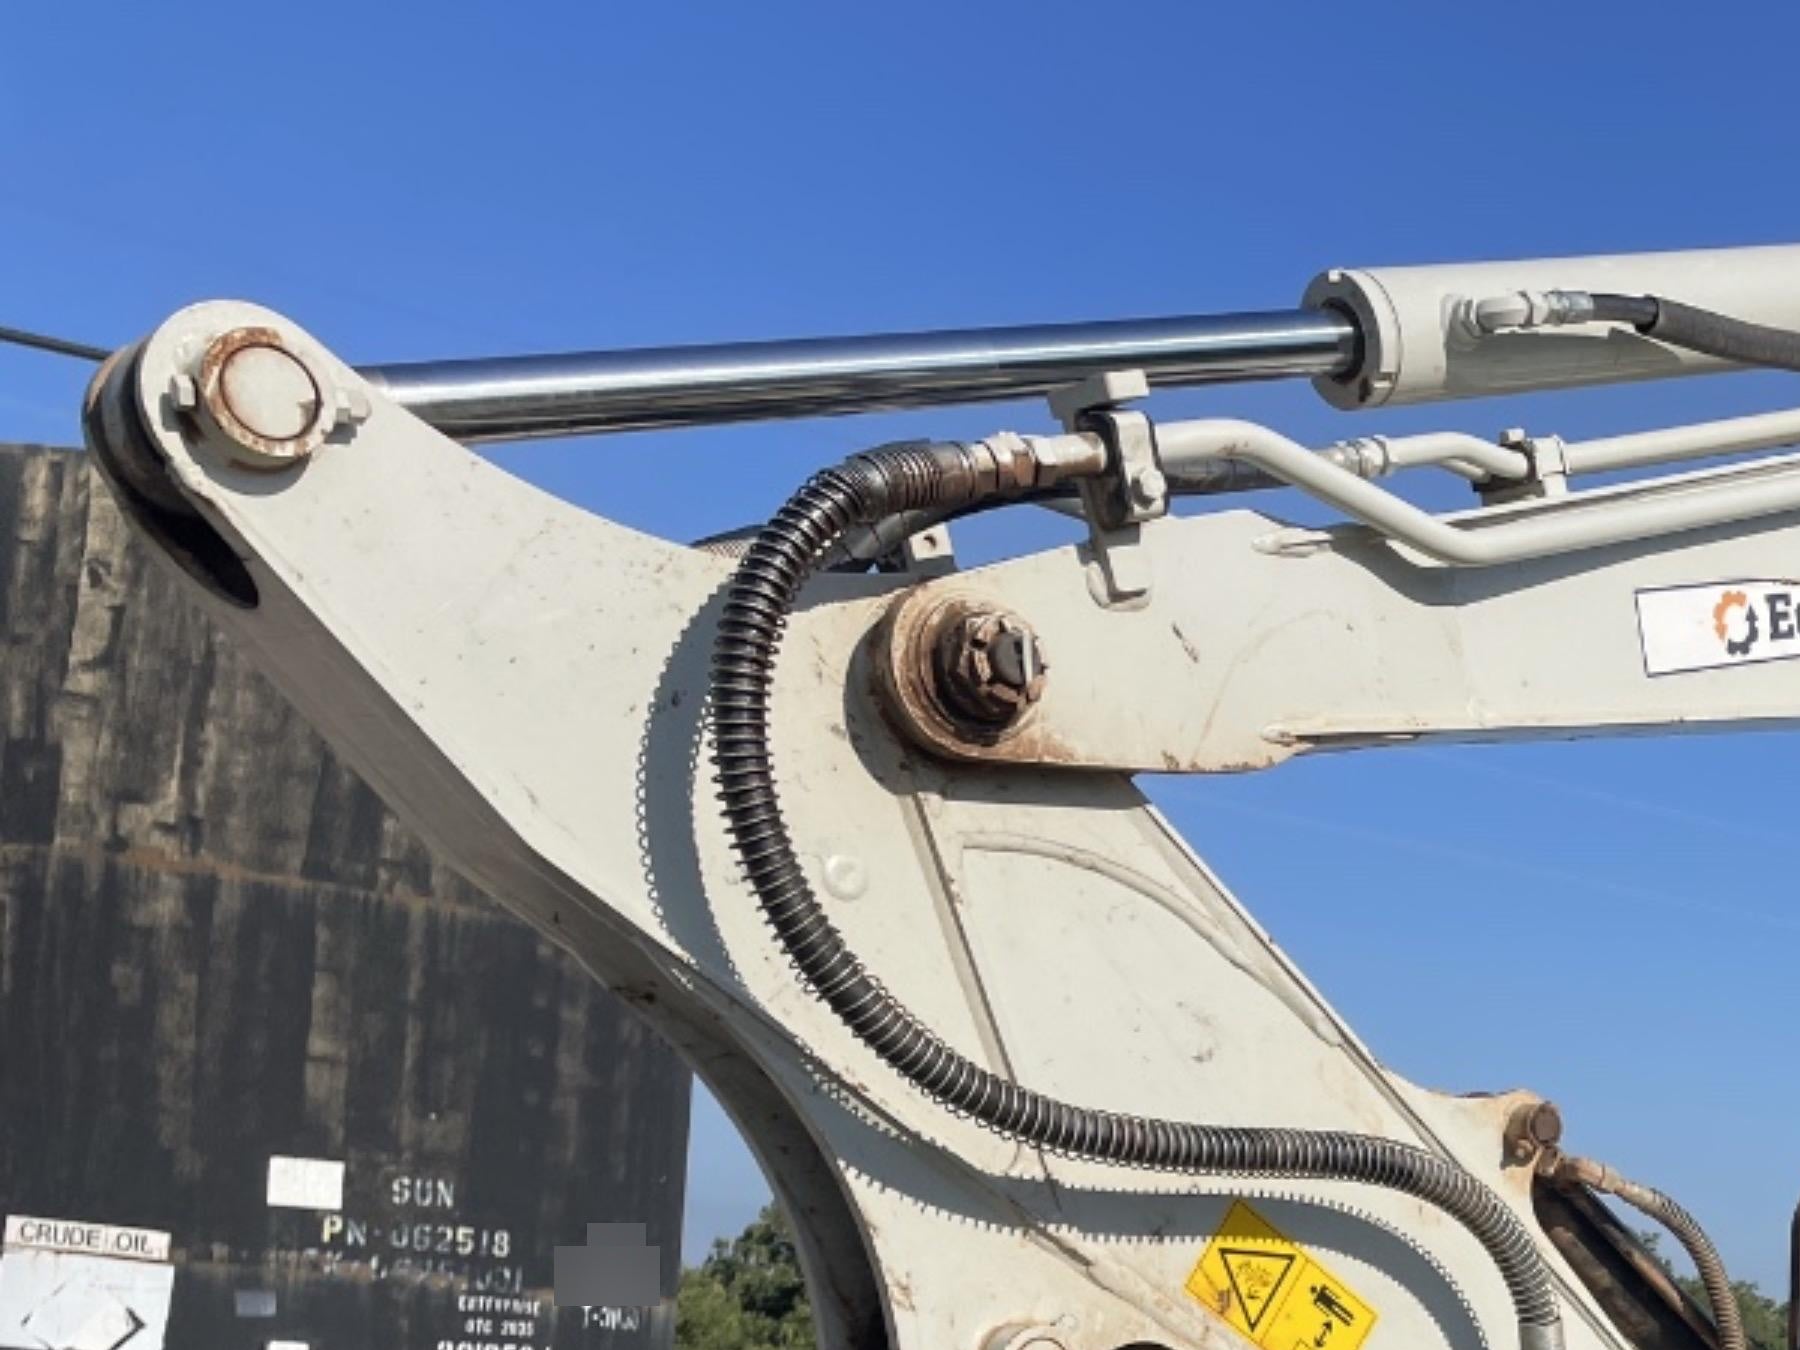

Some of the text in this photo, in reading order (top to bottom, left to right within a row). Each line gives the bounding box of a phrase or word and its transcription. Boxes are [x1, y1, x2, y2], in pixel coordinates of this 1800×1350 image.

[391, 1175, 455, 1209] SUN
[20, 1219, 153, 1254] CRUDE OIL
